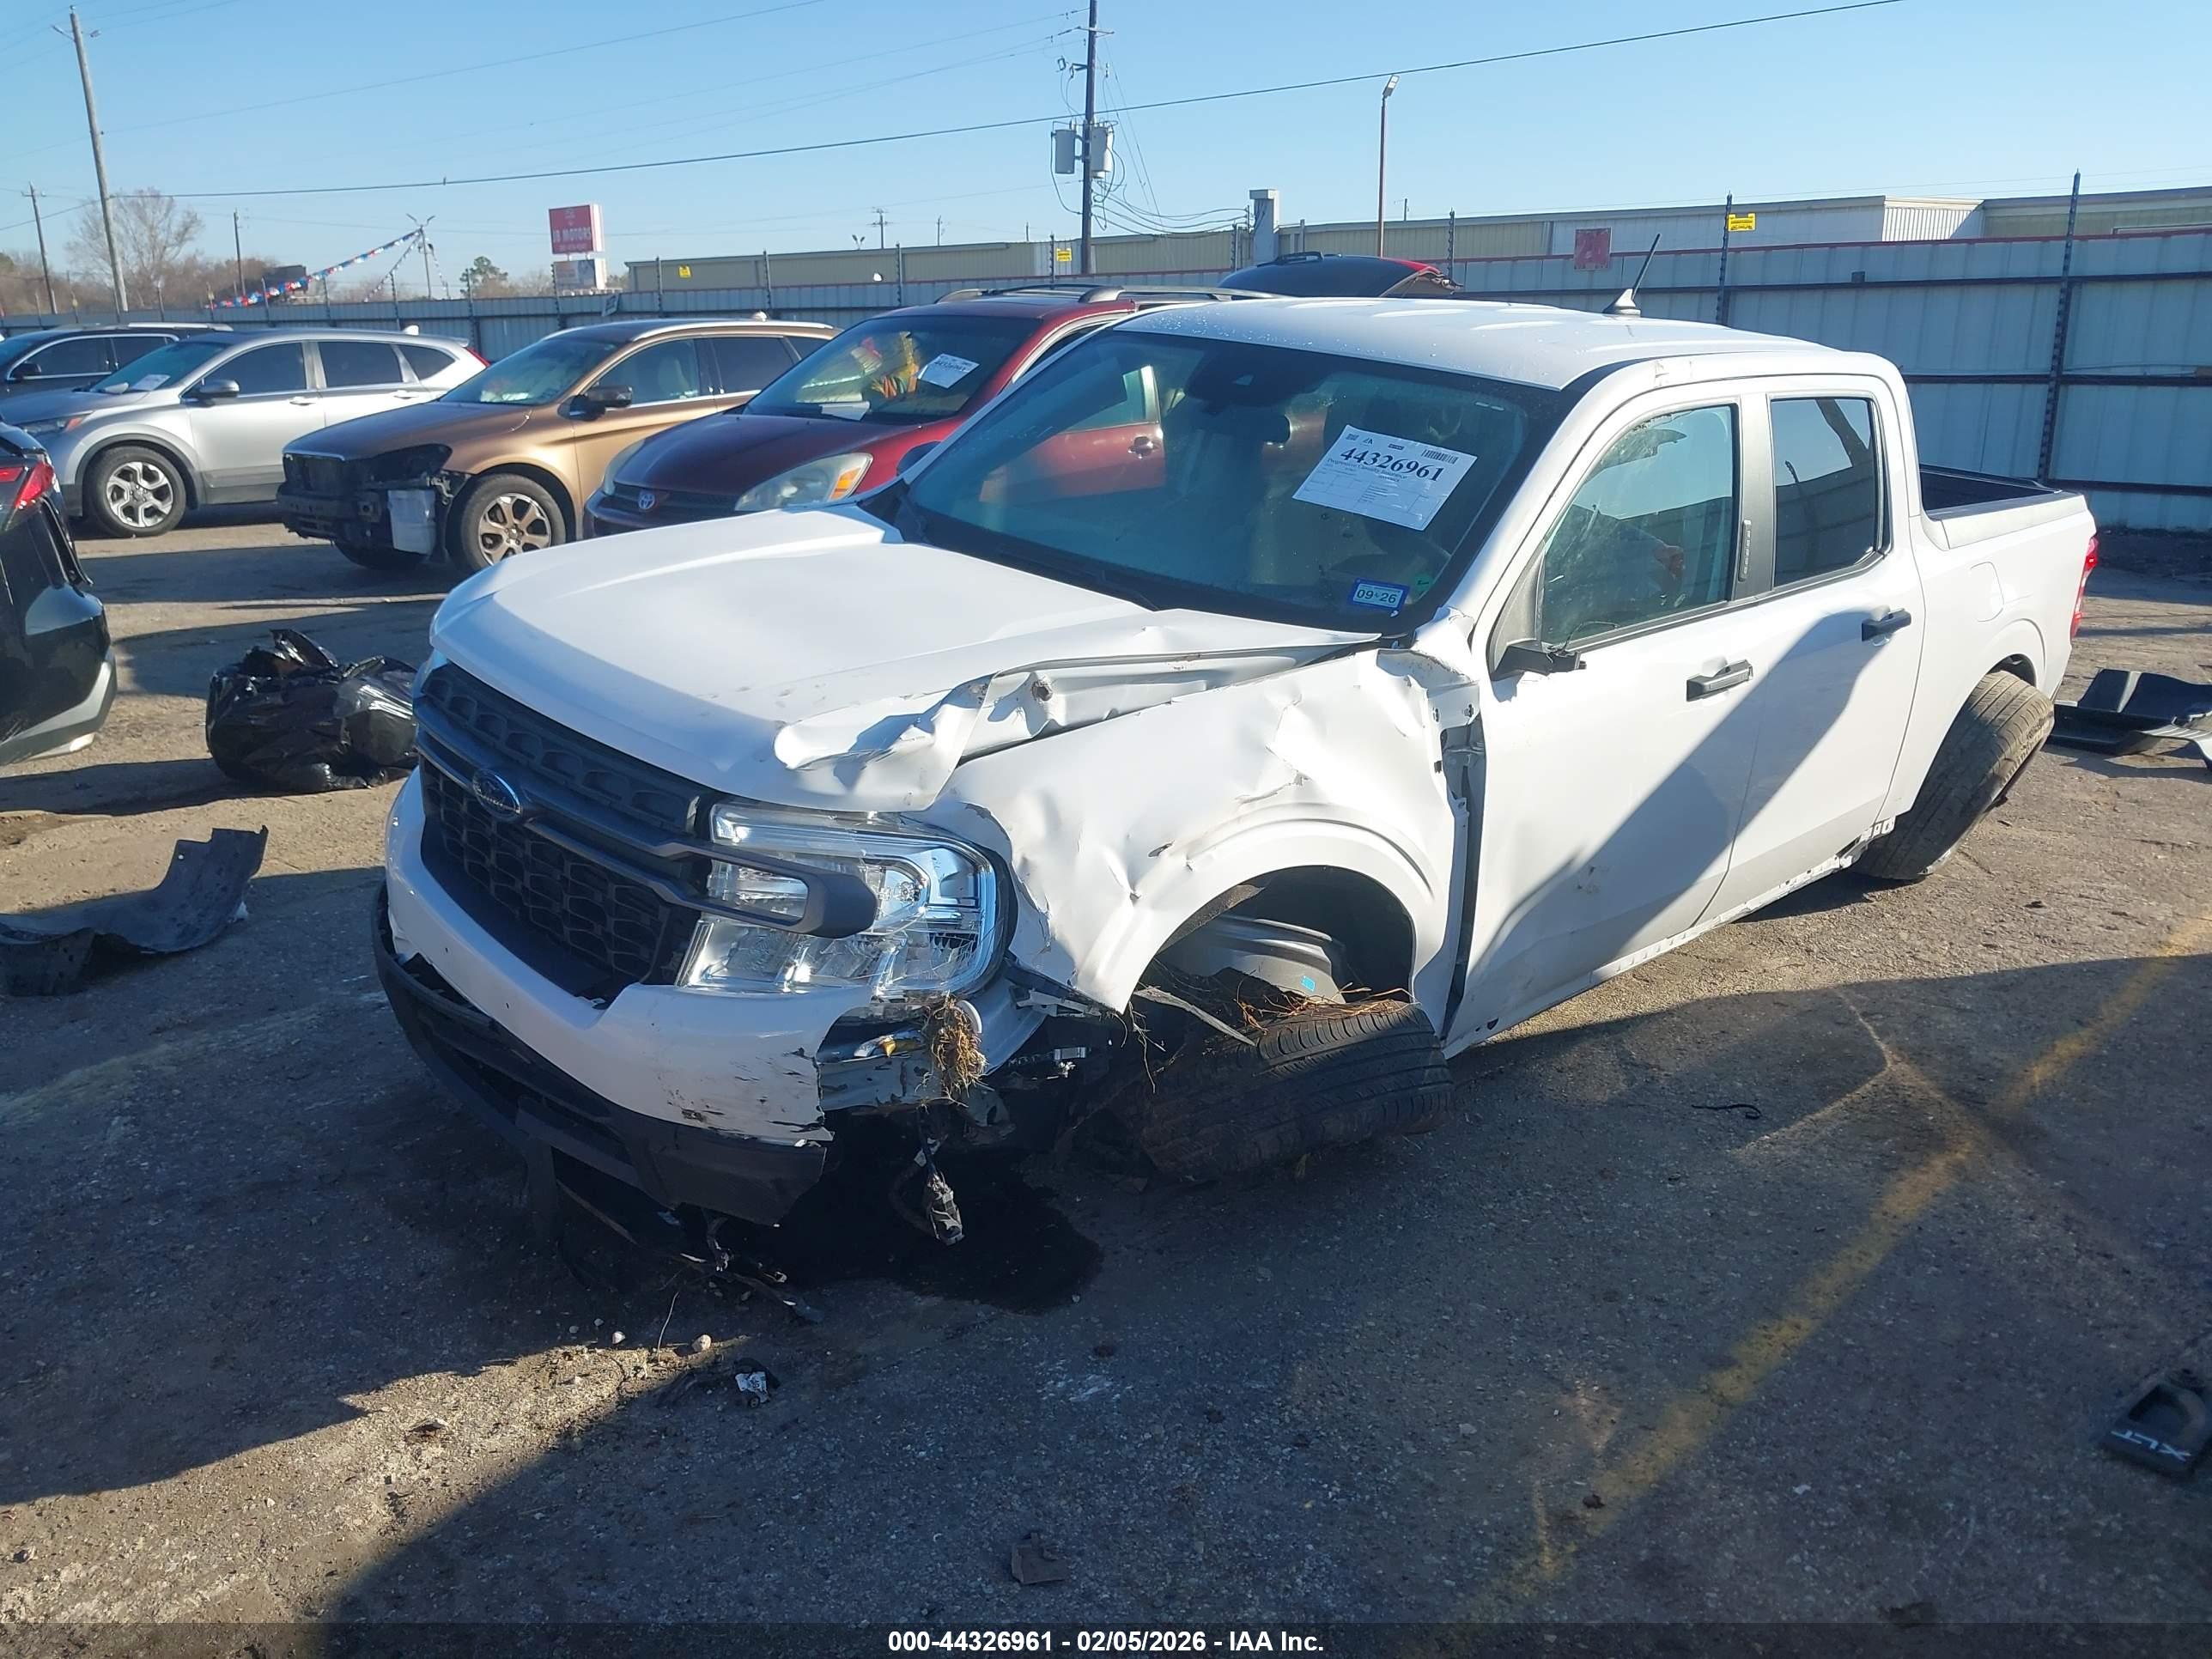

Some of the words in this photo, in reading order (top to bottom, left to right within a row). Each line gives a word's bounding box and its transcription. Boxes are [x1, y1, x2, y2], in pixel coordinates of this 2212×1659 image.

[1340, 447, 1444, 481] 44326961
[1357, 589, 1374, 599] 09
[1379, 592, 1398, 604] 26
[2110, 1430, 2192, 1462] XLT
